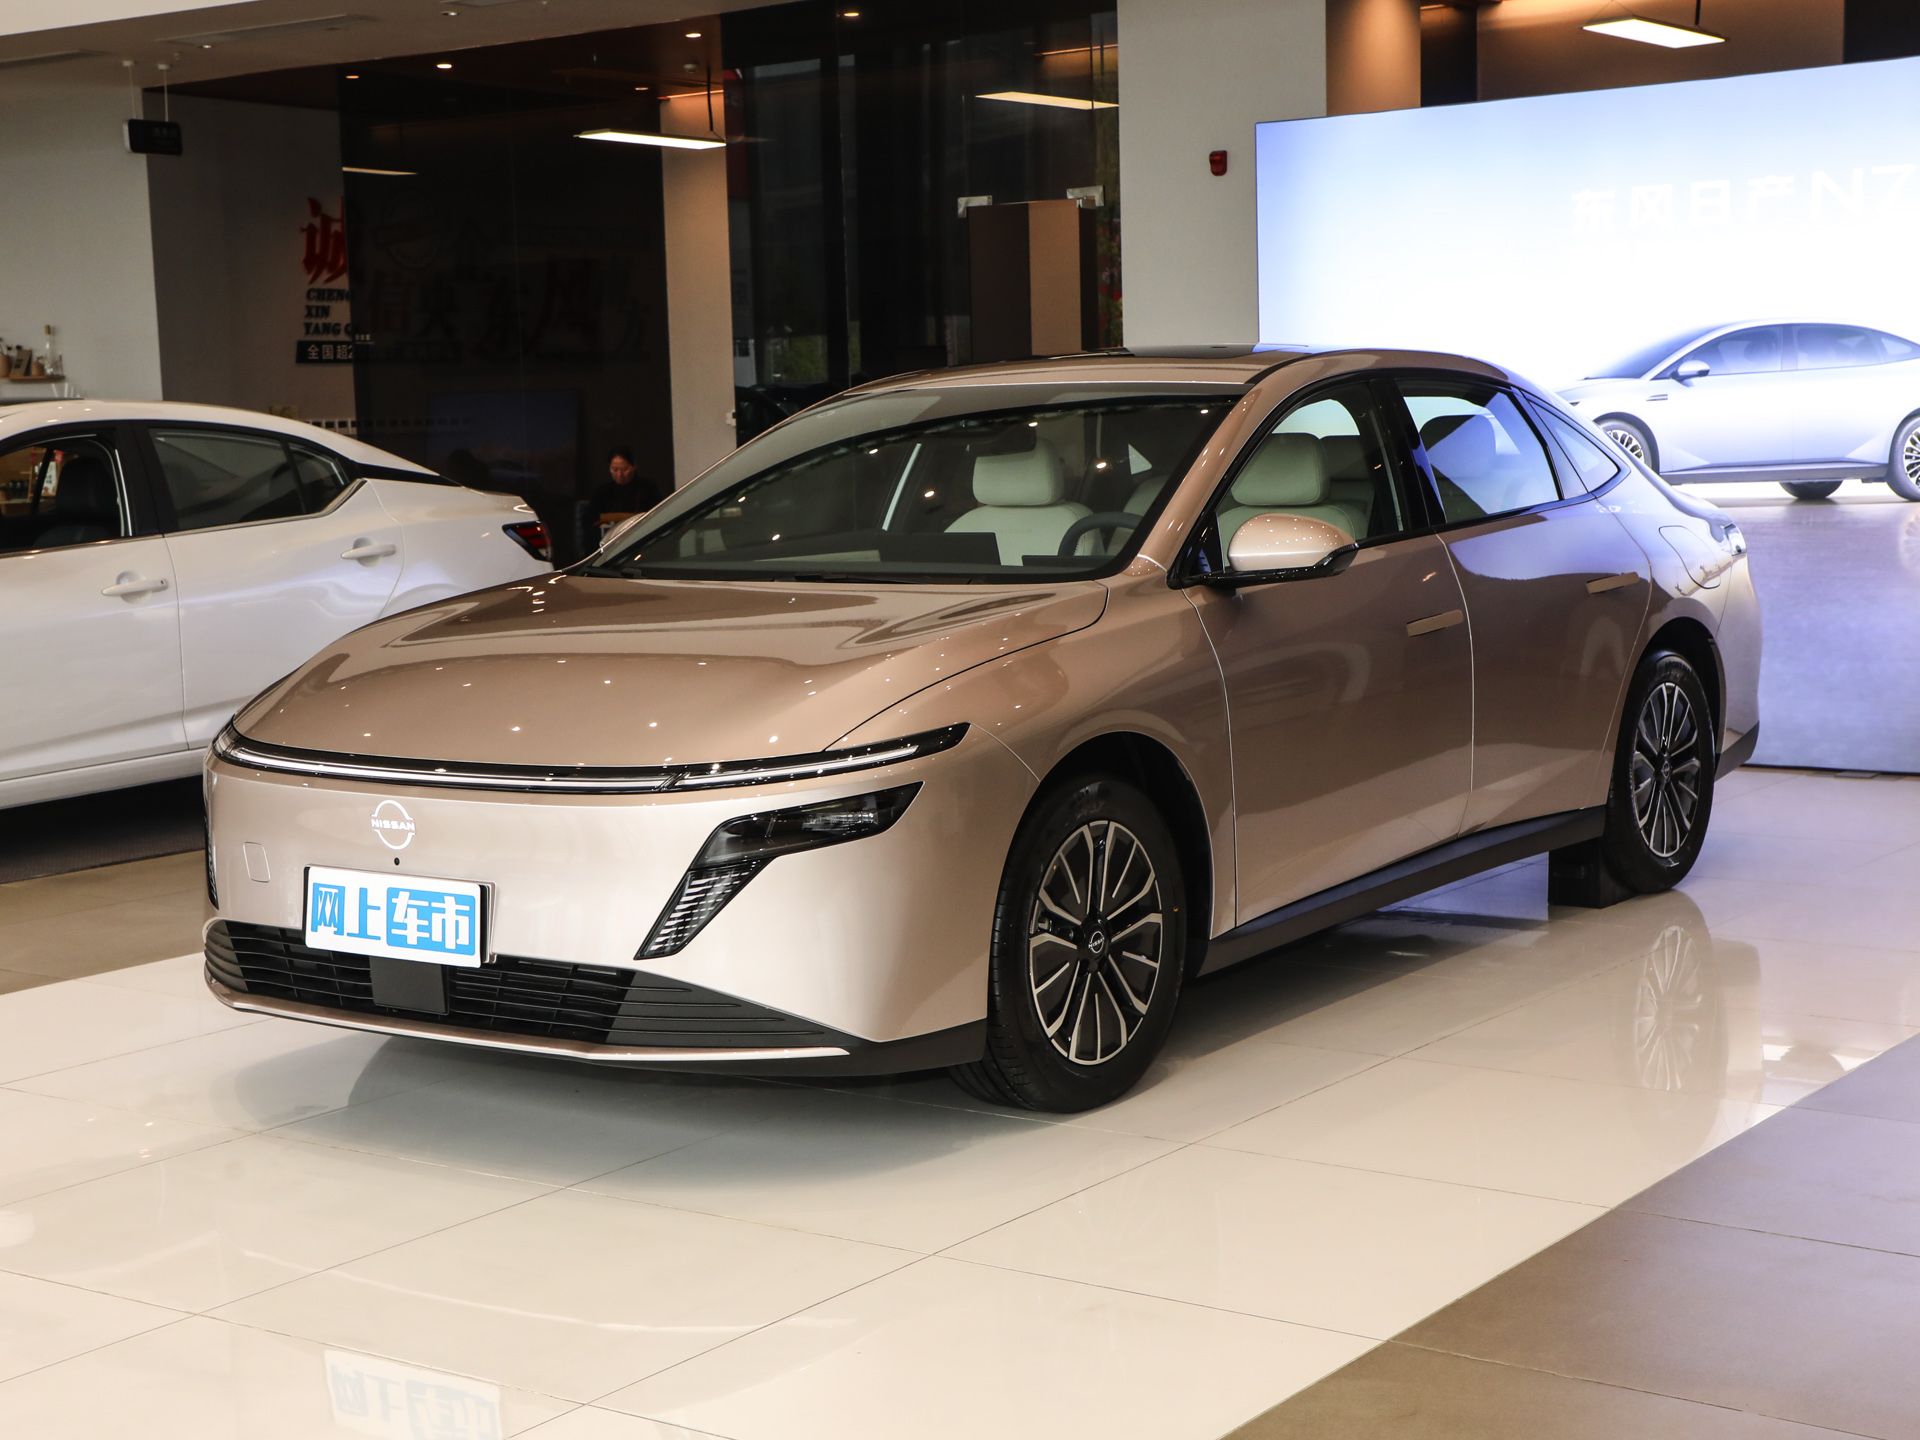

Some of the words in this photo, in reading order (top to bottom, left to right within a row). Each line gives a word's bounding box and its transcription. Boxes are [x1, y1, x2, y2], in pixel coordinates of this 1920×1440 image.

[1570, 163, 1917, 233] 东风日产N7
[305, 304, 330, 319] XIN
[304, 322, 341, 336] YANG
[371, 818, 415, 831] NISSAN
[311, 882, 475, 956] 网上车市
